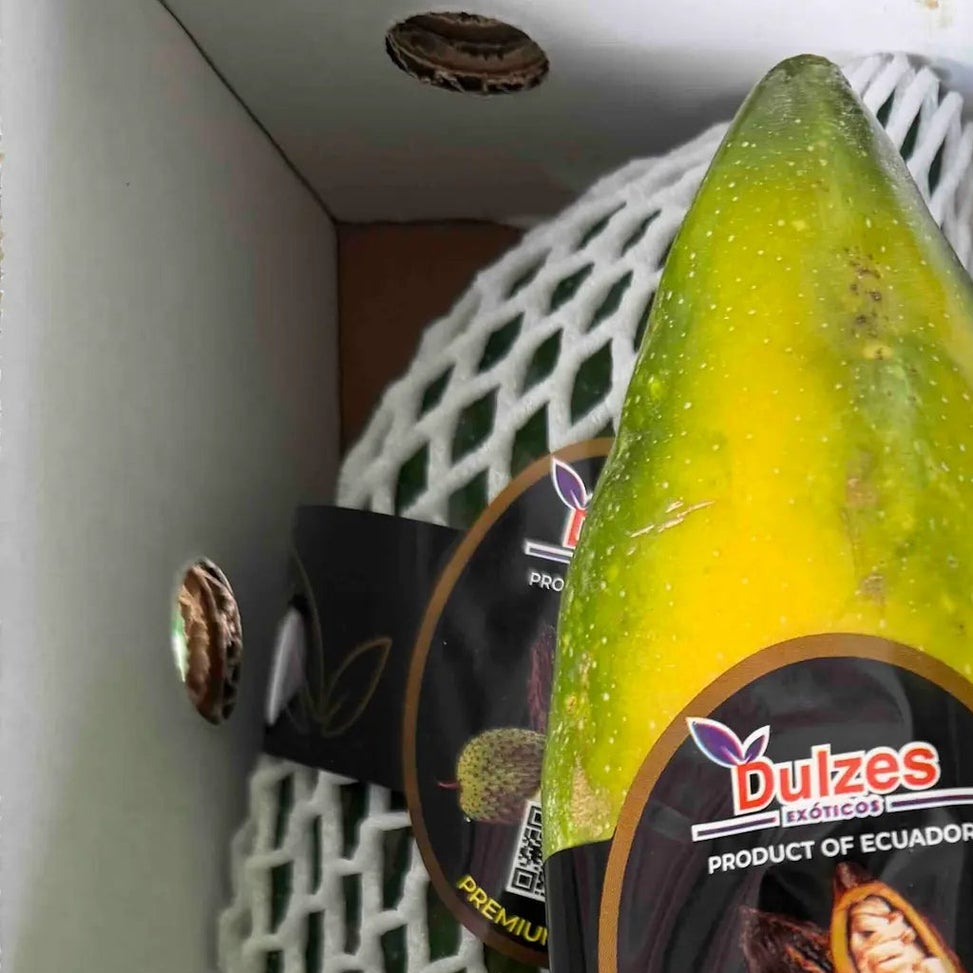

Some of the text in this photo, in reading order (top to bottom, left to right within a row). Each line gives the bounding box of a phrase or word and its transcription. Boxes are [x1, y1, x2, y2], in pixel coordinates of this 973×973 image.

[735, 743, 940, 814] Dulzes
[786, 798, 881, 824] EXÓTICOS
[708, 840, 815, 874] PRODUCT
[821, 836, 855, 857] OF
